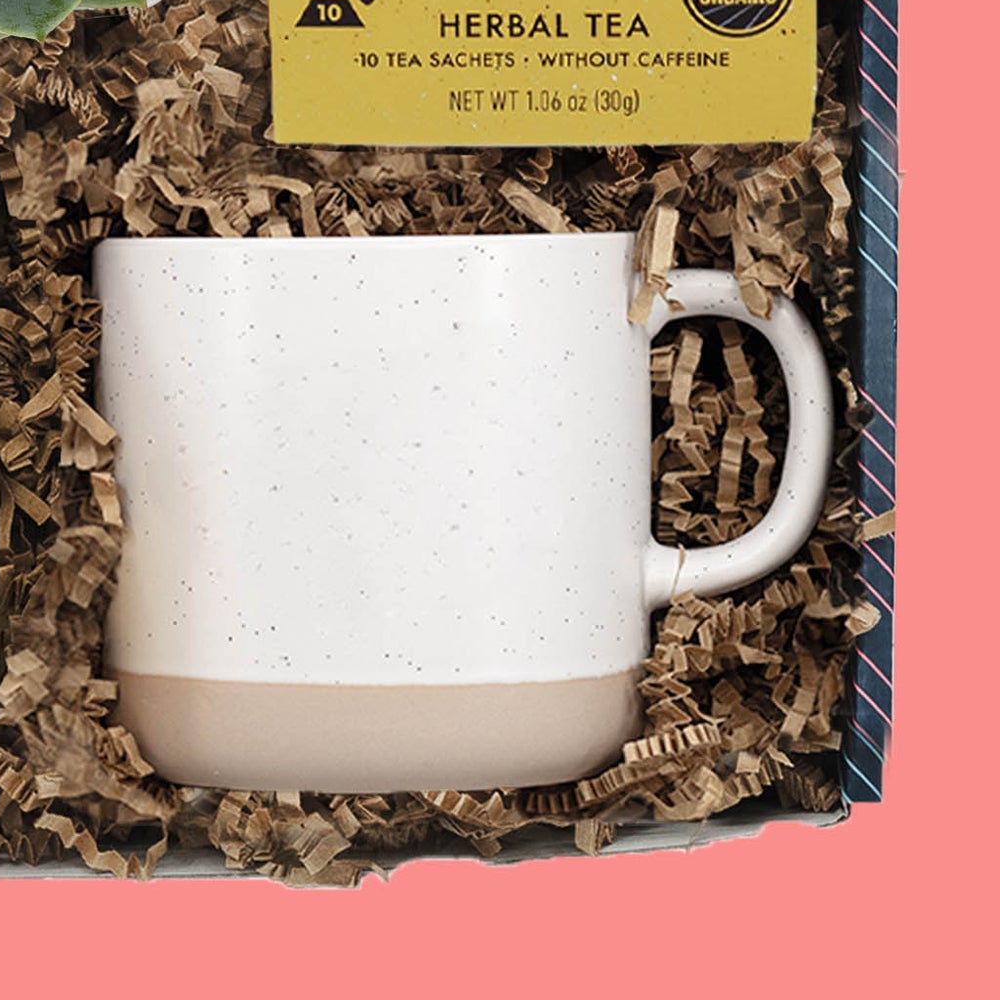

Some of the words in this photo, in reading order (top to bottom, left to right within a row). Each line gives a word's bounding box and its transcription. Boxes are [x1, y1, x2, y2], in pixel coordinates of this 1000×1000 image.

[317, 4, 342, 22] 10
[440, 13, 569, 38] HERBAL
[586, 13, 650, 37] TEA
[386, 53, 422, 68] TEA
[430, 52, 515, 68] SACHETS
[538, 52, 629, 68] WITHOUT
[638, 52, 730, 68] CAFFEINE
[449, 90, 484, 112] NET
[490, 90, 519, 112] WT
[526, 90, 562, 112] 1.06
[567, 96, 587, 111] oz
[594, 88, 641, 116] (30g)
